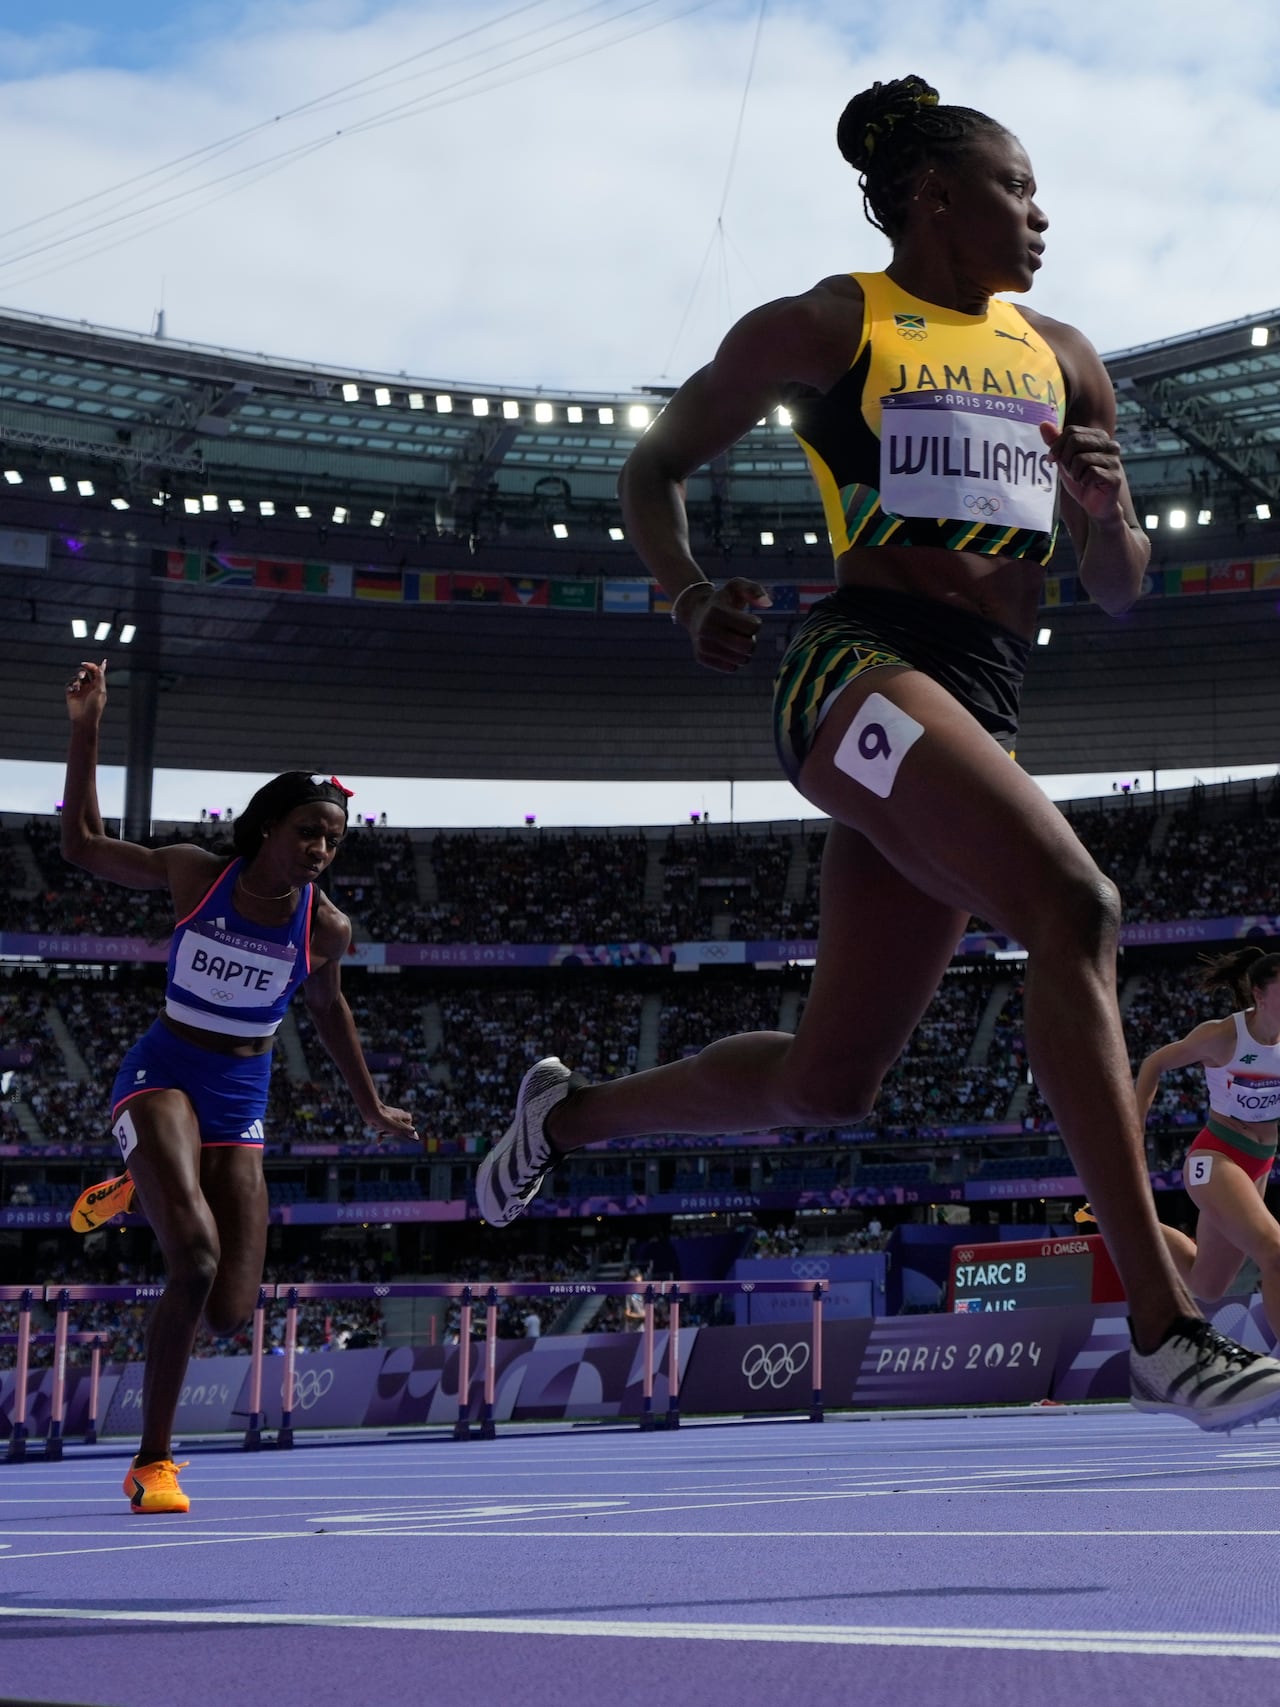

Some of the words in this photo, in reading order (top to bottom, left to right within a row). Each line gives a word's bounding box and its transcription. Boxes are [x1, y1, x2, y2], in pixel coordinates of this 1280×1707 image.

[889, 362, 1060, 412] JAMAICA
[934, 394, 981, 409] PARIS
[985, 400, 1025, 415] 2024
[889, 434, 1053, 492] WILLIAMS
[1119, 928, 1161, 941] PARIS
[1167, 925, 1205, 938] 2024
[38, 940, 88, 953] PARIS
[214, 931, 240, 945] PARIS
[243, 940, 269, 952] 2024
[420, 949, 467, 961] PARIS
[473, 949, 516, 961] 2024
[778, 943, 817, 956] PARI
[191, 949, 274, 991] BAPTE
[1195, 1162, 1204, 1179] 5
[990, 1183, 1027, 1195] PARIS
[681, 1197, 720, 1209] PARIS
[725, 1195, 760, 1207] 2024
[6, 1213, 50, 1225] PARIS
[336, 1207, 378, 1218] PARIS
[1053, 1241, 1089, 1255] OMEGA
[955, 1262, 1012, 1288] STARC
[1015, 1262, 1026, 1283] B
[136, 1288, 165, 1297] PARIS
[550, 1286, 573, 1294] PARIS
[575, 1285, 597, 1293] 2024
[876, 1345, 957, 1373] PARIS
[964, 1341, 1042, 1369] 2024
[179, 1384, 229, 1407] 2024
